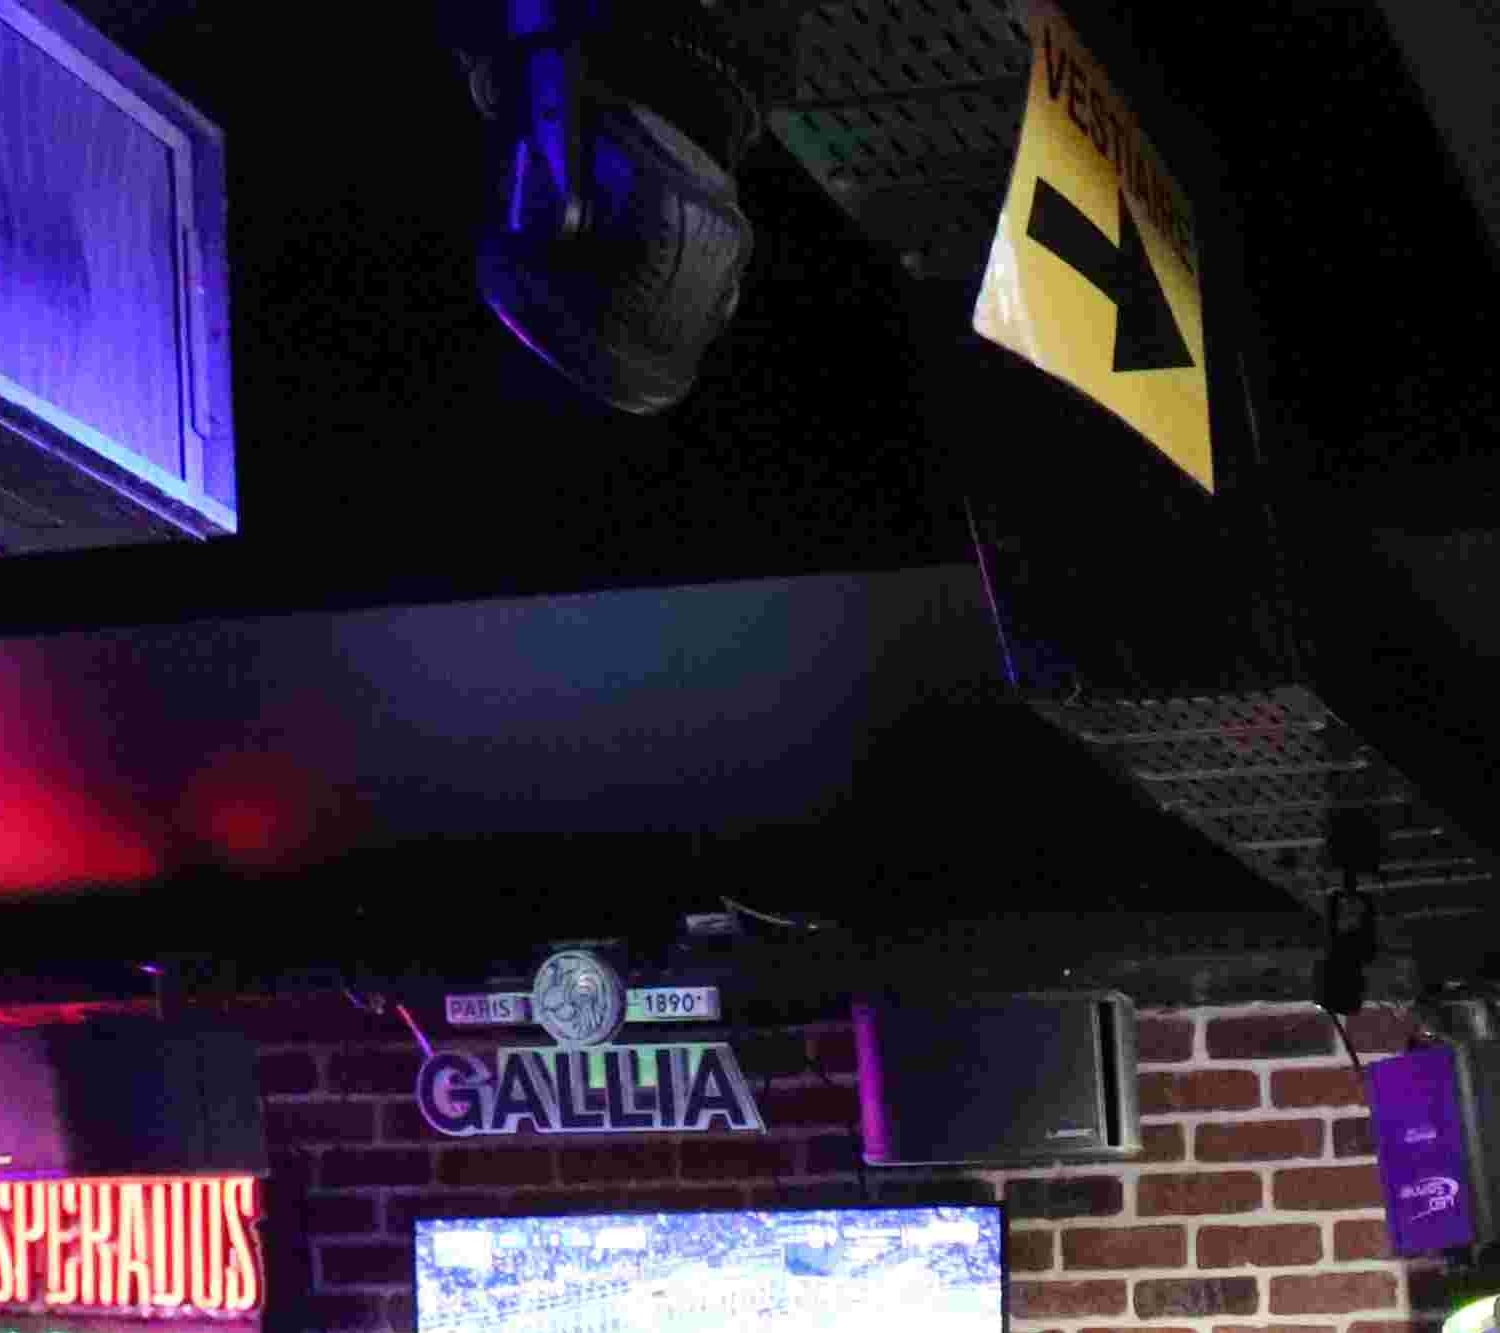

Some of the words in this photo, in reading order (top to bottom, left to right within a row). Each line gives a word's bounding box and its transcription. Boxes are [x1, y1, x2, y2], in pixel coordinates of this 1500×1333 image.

[450, 996, 511, 1020] PARIS
[645, 990, 696, 1014] 1890
[419, 1045, 764, 1136] GALLIA
